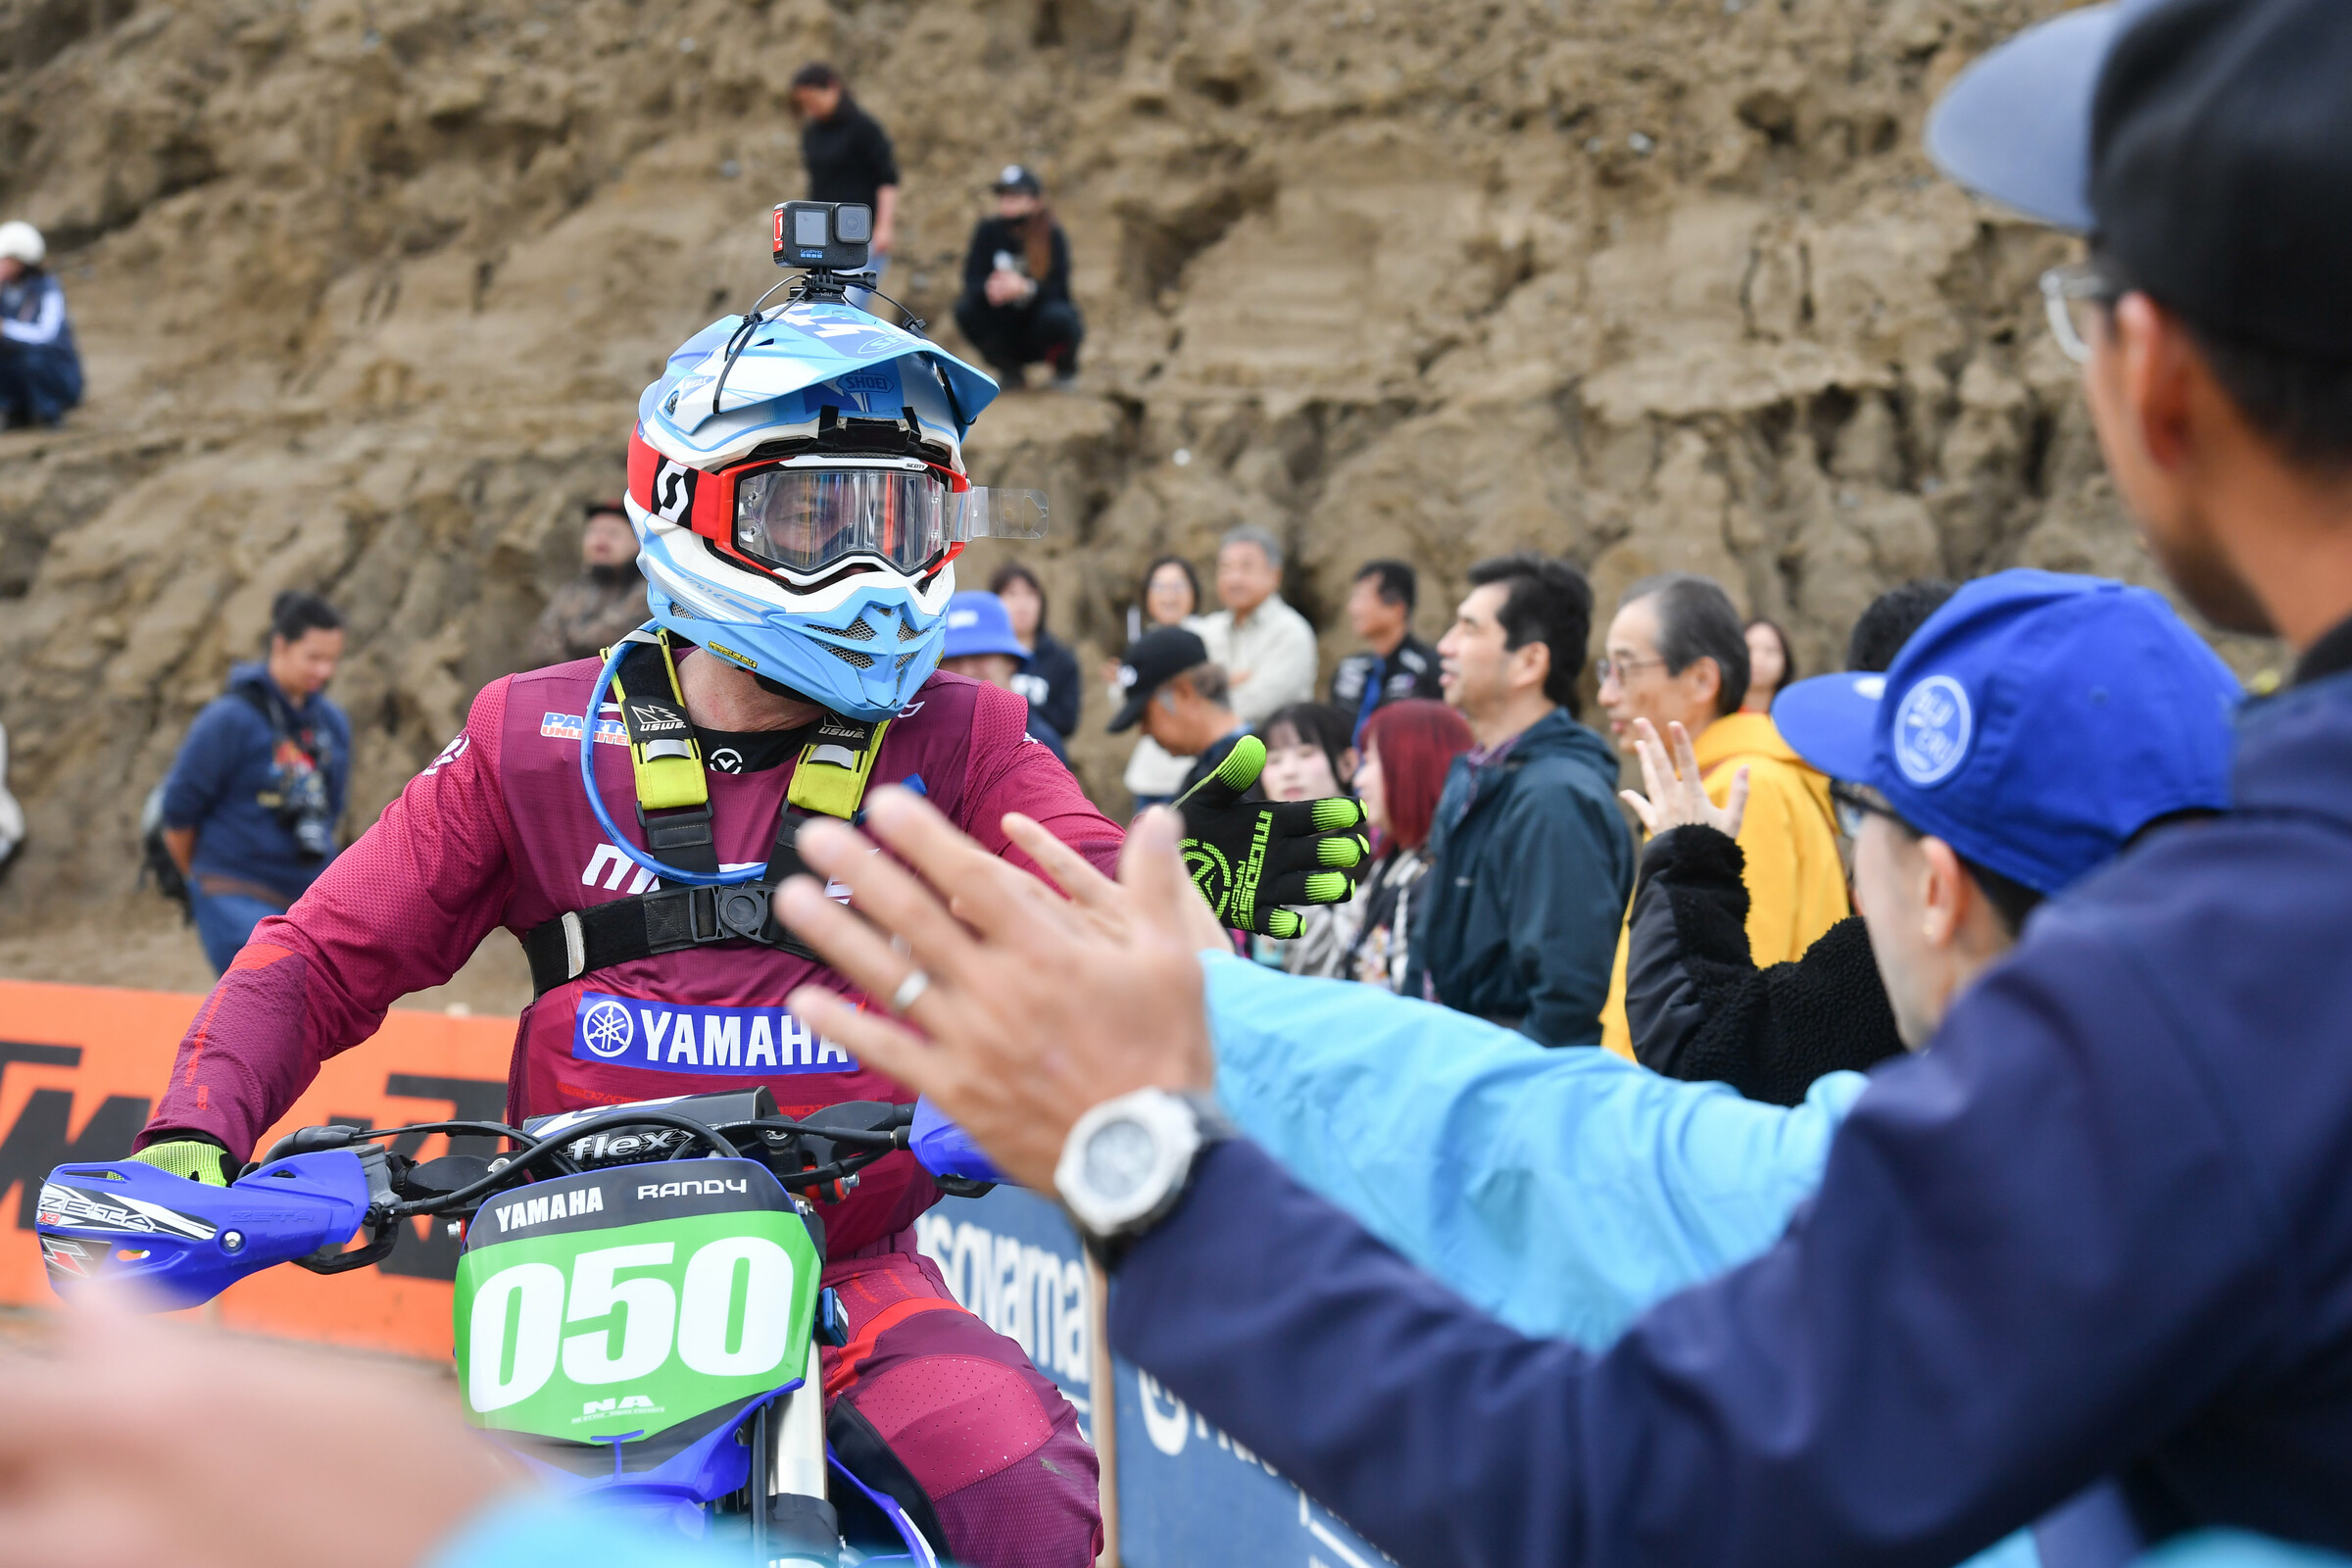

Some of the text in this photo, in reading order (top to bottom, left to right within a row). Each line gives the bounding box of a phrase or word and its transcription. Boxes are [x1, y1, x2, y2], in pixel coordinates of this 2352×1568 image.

[847, 373, 888, 391] SHOEI
[39, 1193, 156, 1234] ZETA
[495, 1178, 748, 1233] YAMAHA RANDY
[38, 1211, 61, 1225] X3
[230, 1209, 315, 1223] ZETA
[469, 1236, 794, 1413] 050
[583, 1395, 655, 1415] NA
